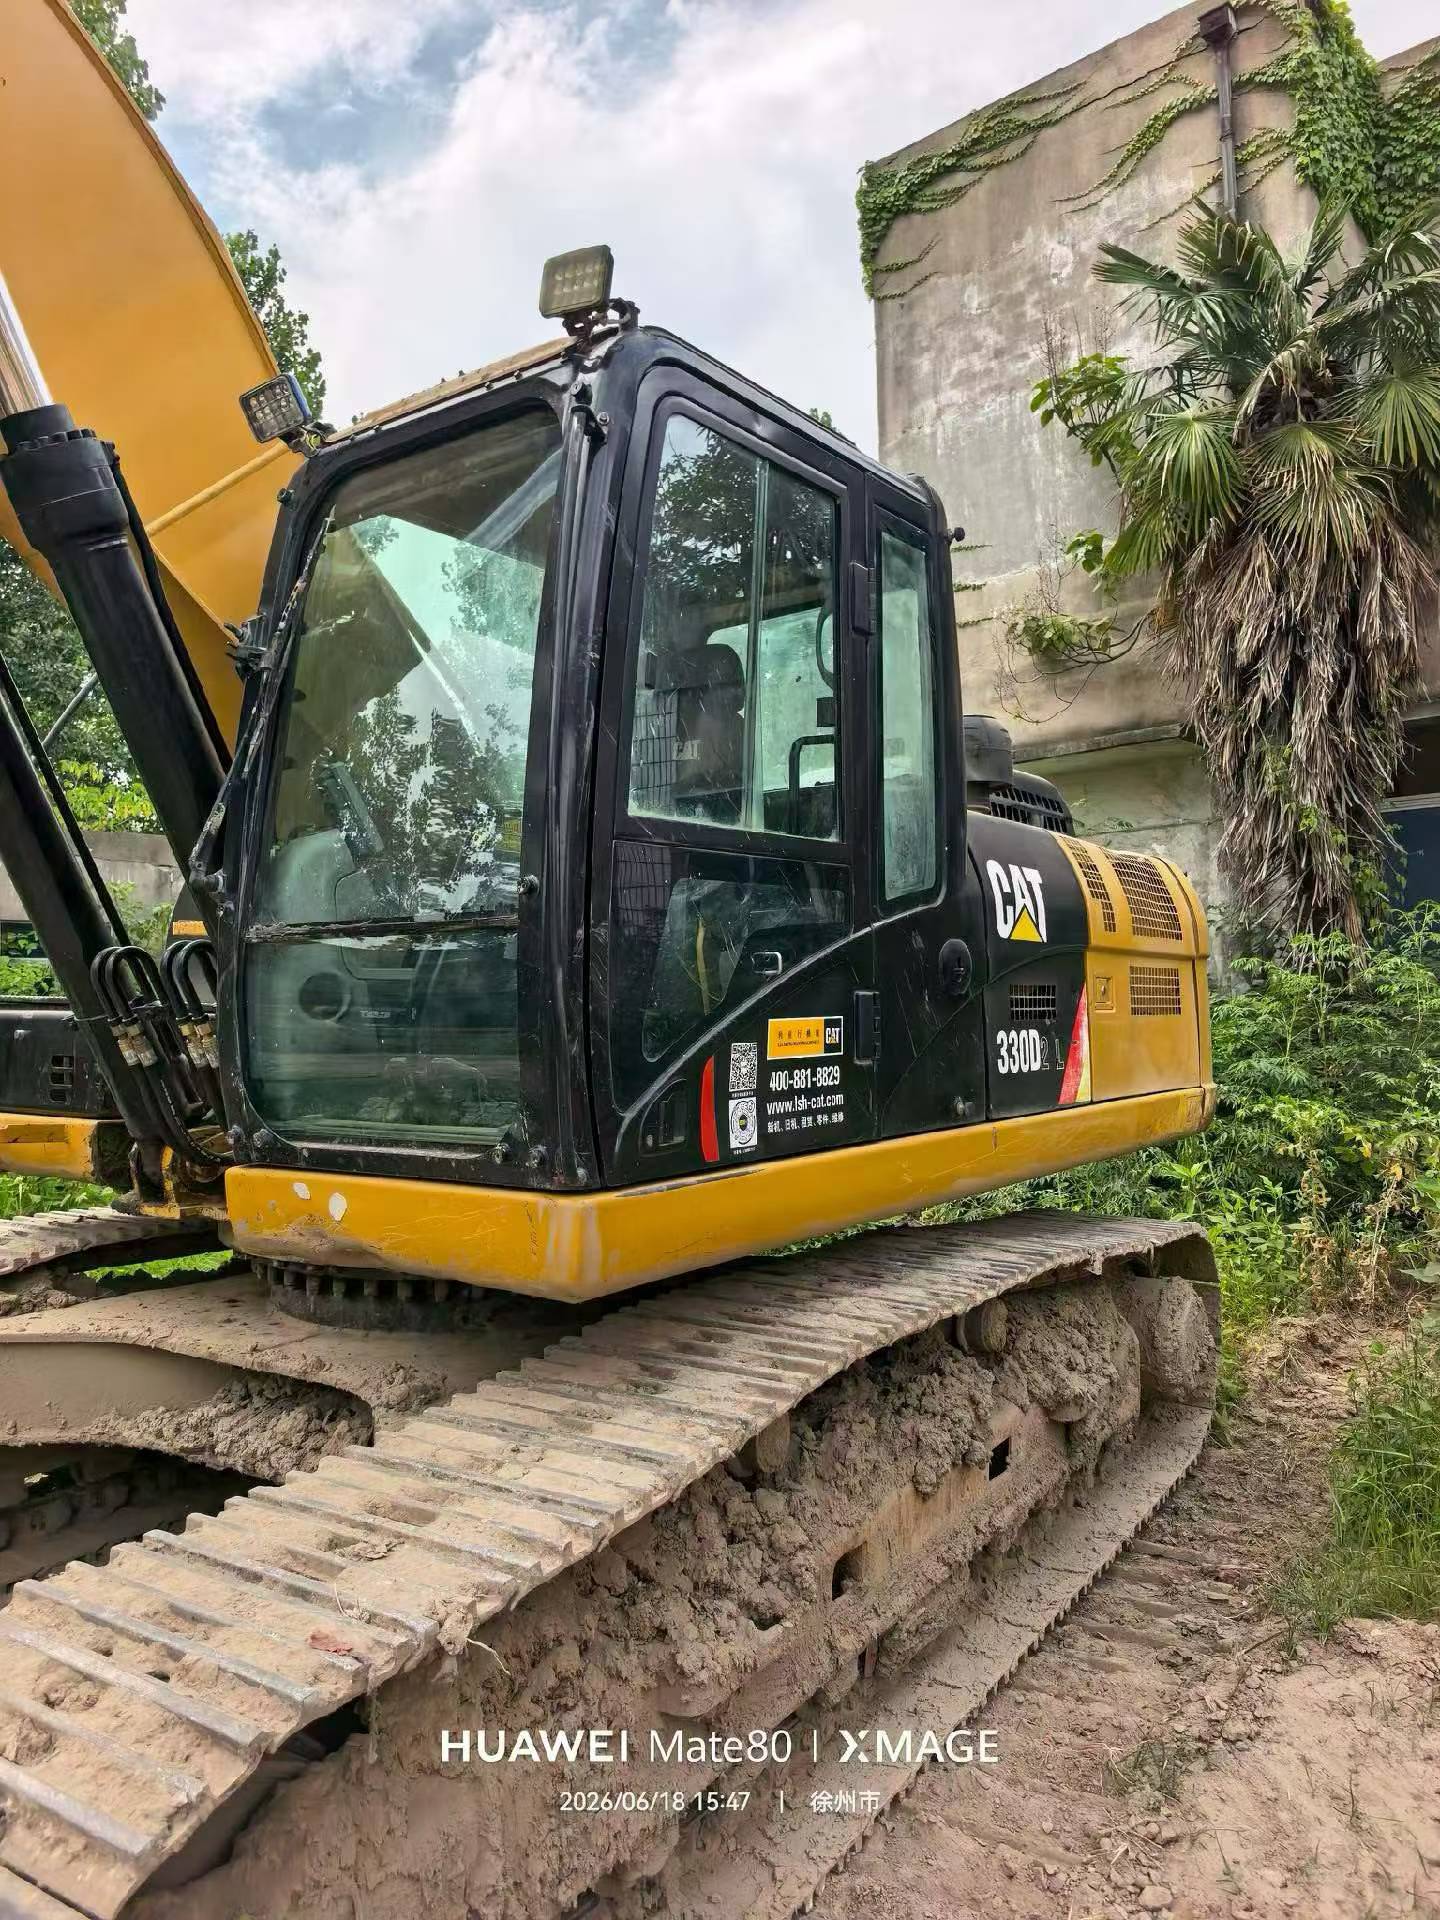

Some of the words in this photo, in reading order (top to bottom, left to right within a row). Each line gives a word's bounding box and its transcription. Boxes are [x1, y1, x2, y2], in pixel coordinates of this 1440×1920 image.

[986, 860, 1047, 943] CAT
[825, 1027, 840, 1044] CAT
[769, 1065, 840, 1091] 400-881-8829
[766, 1093, 844, 1115] www.lsh-cat.com
